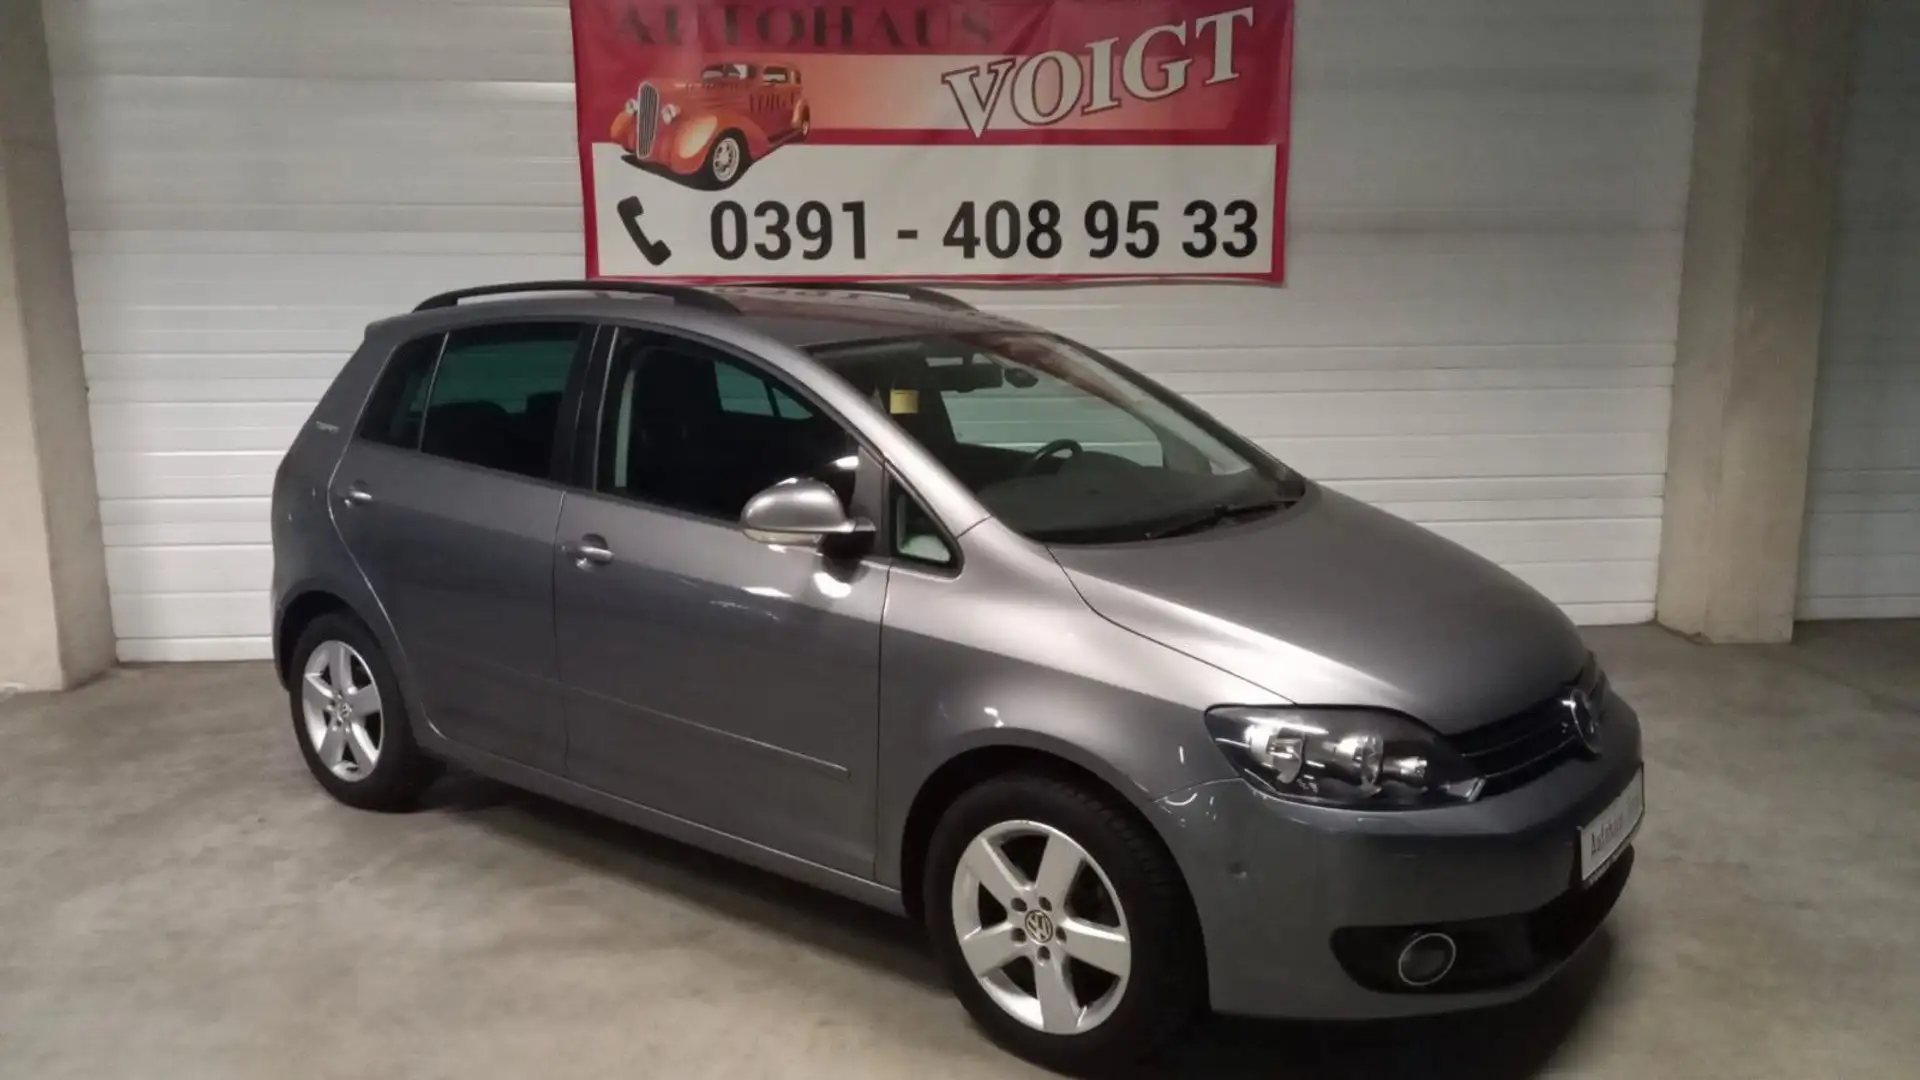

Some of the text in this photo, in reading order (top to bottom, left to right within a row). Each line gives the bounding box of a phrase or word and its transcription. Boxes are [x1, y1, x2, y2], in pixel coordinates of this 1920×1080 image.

[617, 4, 995, 46] AUTOHAUS
[941, 7, 1254, 138] VOIGT
[710, 199, 1258, 260] 0391 - 408 95 33
